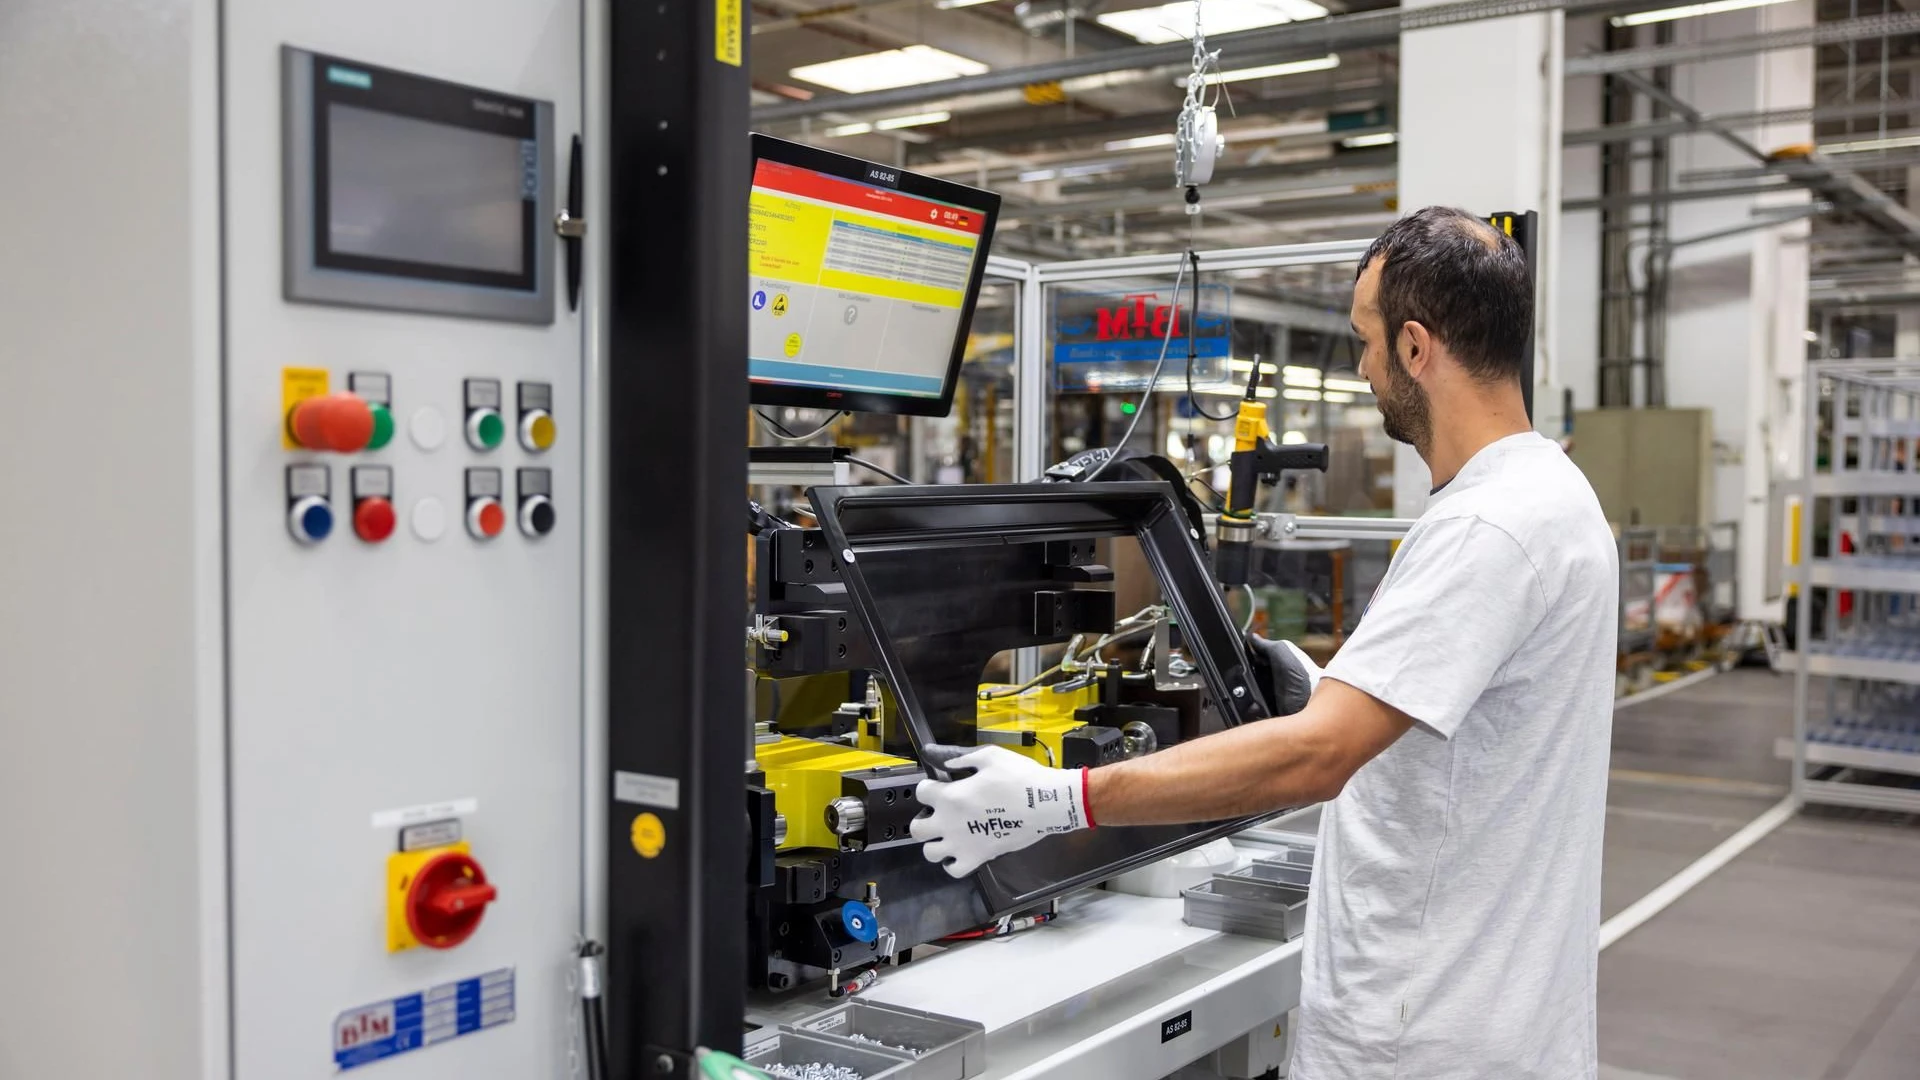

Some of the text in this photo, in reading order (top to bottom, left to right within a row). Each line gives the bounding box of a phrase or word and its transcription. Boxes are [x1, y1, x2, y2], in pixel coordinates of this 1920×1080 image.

[870, 170, 895, 182] AS 82-85
[967, 818, 1021, 836] HyFlex
[1166, 1018, 1188, 1034] AS 82-85
